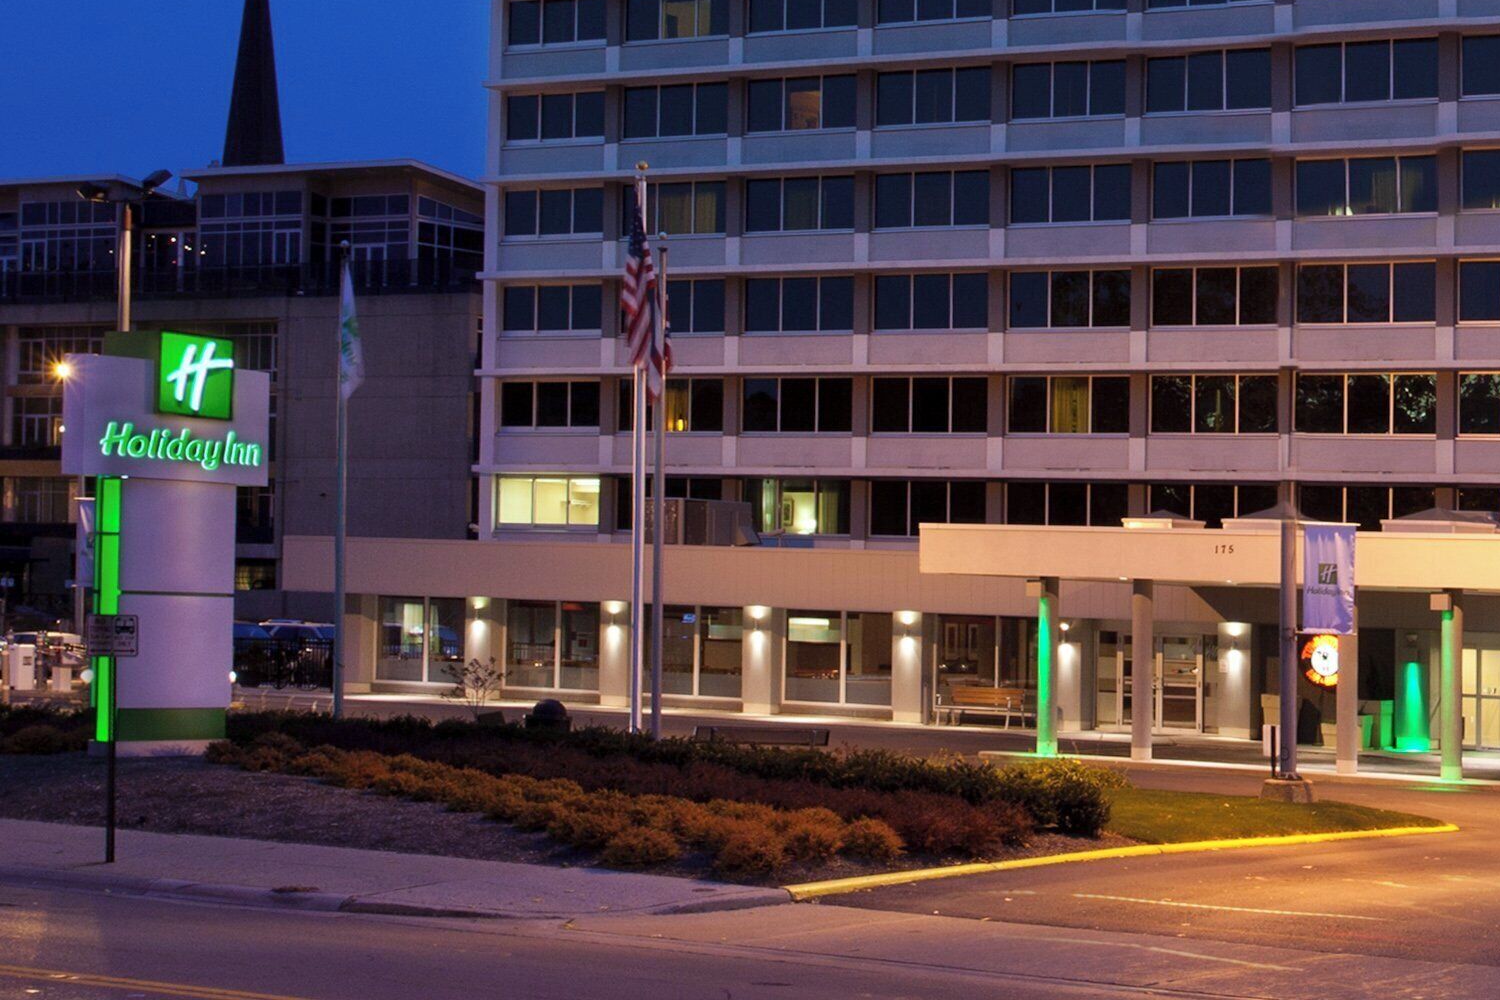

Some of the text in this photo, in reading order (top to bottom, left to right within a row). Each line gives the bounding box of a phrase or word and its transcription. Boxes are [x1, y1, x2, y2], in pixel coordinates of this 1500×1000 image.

[166, 341, 234, 411] H
[99, 421, 262, 471] Holiday Inn
[1215, 544, 1234, 554] 175
[1306, 585, 1337, 597] Holiday
